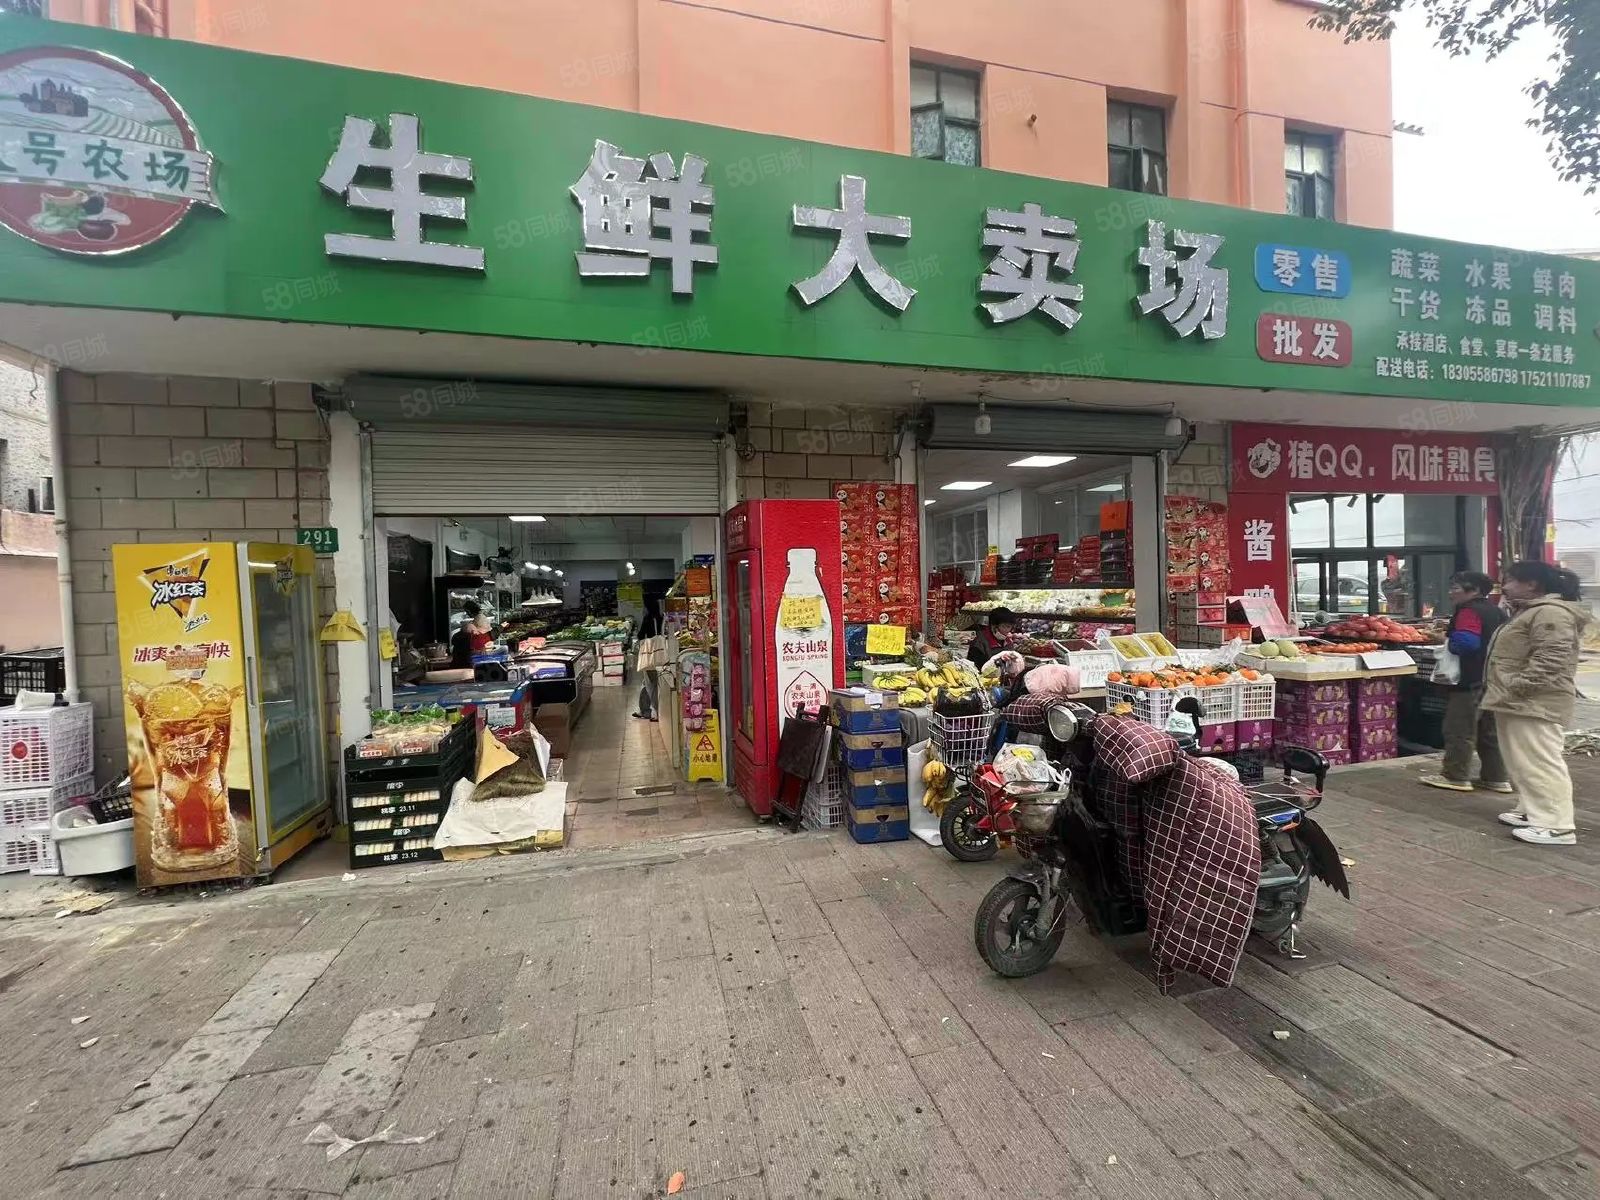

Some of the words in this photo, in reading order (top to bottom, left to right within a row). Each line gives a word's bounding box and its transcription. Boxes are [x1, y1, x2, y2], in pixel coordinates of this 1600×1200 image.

[0, 131, 189, 192] 号农场
[319, 113, 1229, 340] 生鲜大卖场
[1272, 248, 1339, 292] 零售
[1391, 247, 1440, 283] 蔬菜
[1465, 258, 1511, 291] 水果
[1533, 267, 1576, 300] 鲜肉
[1391, 287, 1441, 321] 干货
[1465, 295, 1512, 327] 冻品
[1534, 303, 1577, 335] 调料
[1272, 319, 1340, 360] 批发
[1391, 443, 1496, 483] 风味熟食
[303, 530, 332, 545] 291
[151, 580, 205, 608] 冰红茶
[782, 640, 828, 654] 农夫山泉
[791, 690, 820, 699] 农夫山泉
